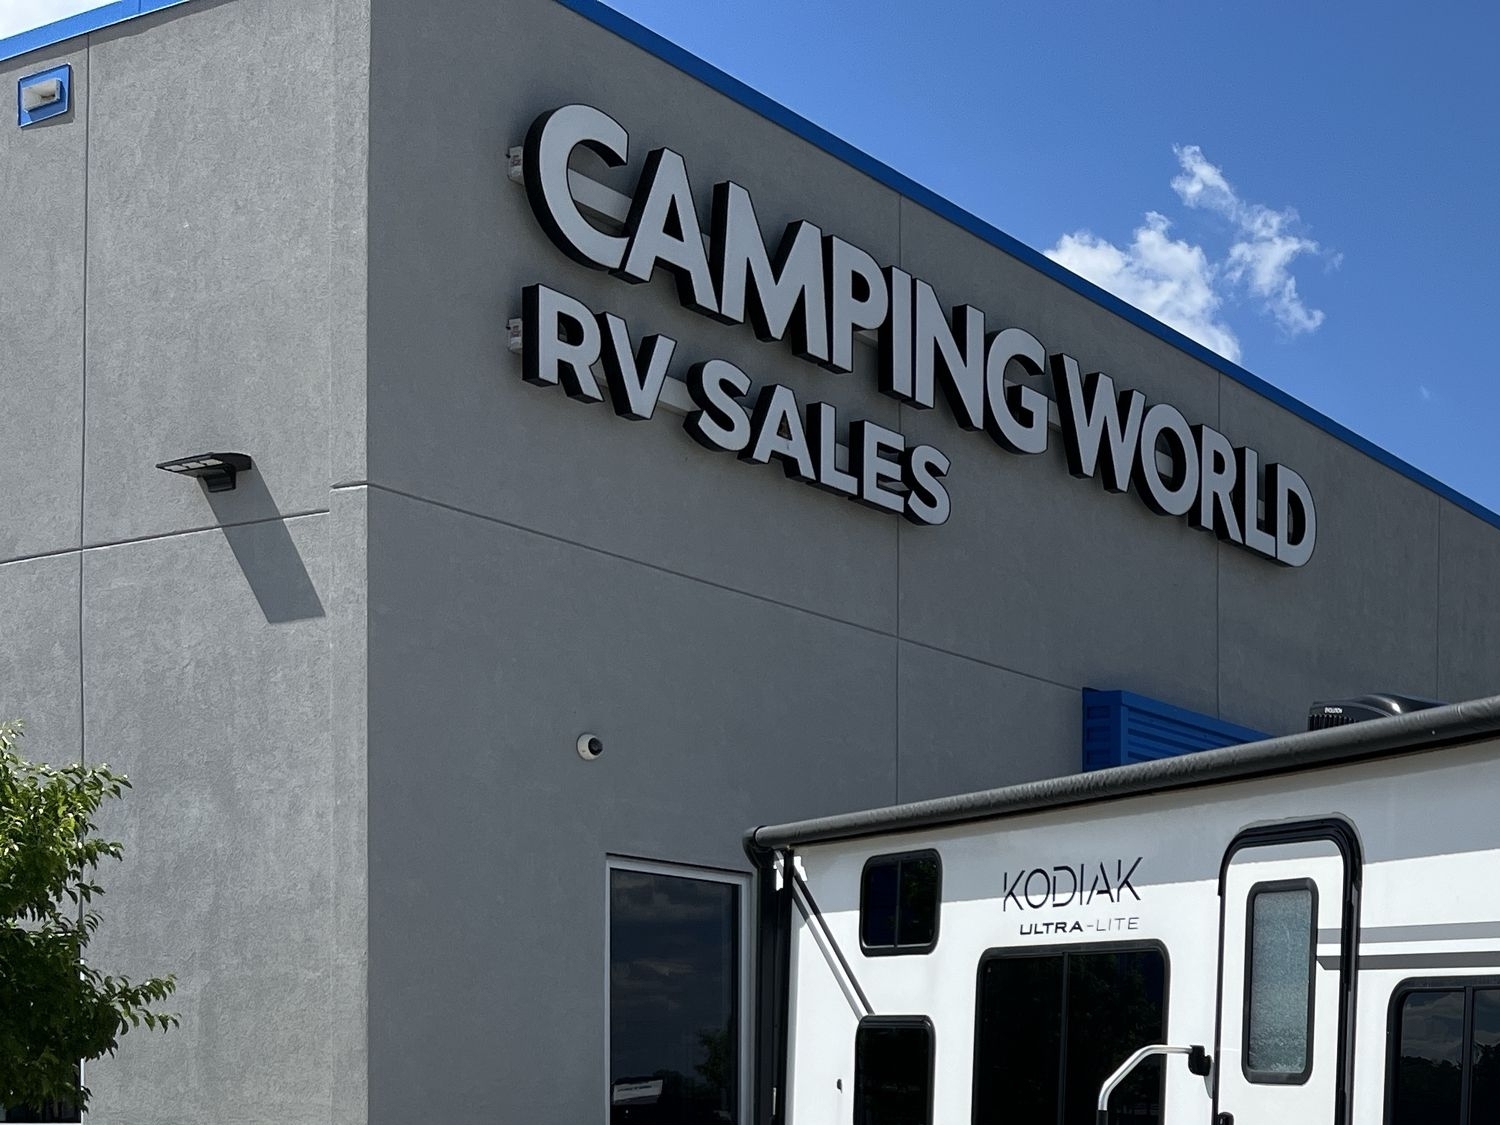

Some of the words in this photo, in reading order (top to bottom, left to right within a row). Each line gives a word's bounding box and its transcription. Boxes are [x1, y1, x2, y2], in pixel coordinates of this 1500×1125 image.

[522, 283, 678, 421] RV
[683, 358, 952, 526] SALES
[524, 103, 1050, 455] CAMPING
[1050, 353, 1318, 568] WORLD
[1003, 856, 1144, 912] KODIAK
[1019, 916, 1140, 936] ULTRA-LITE
